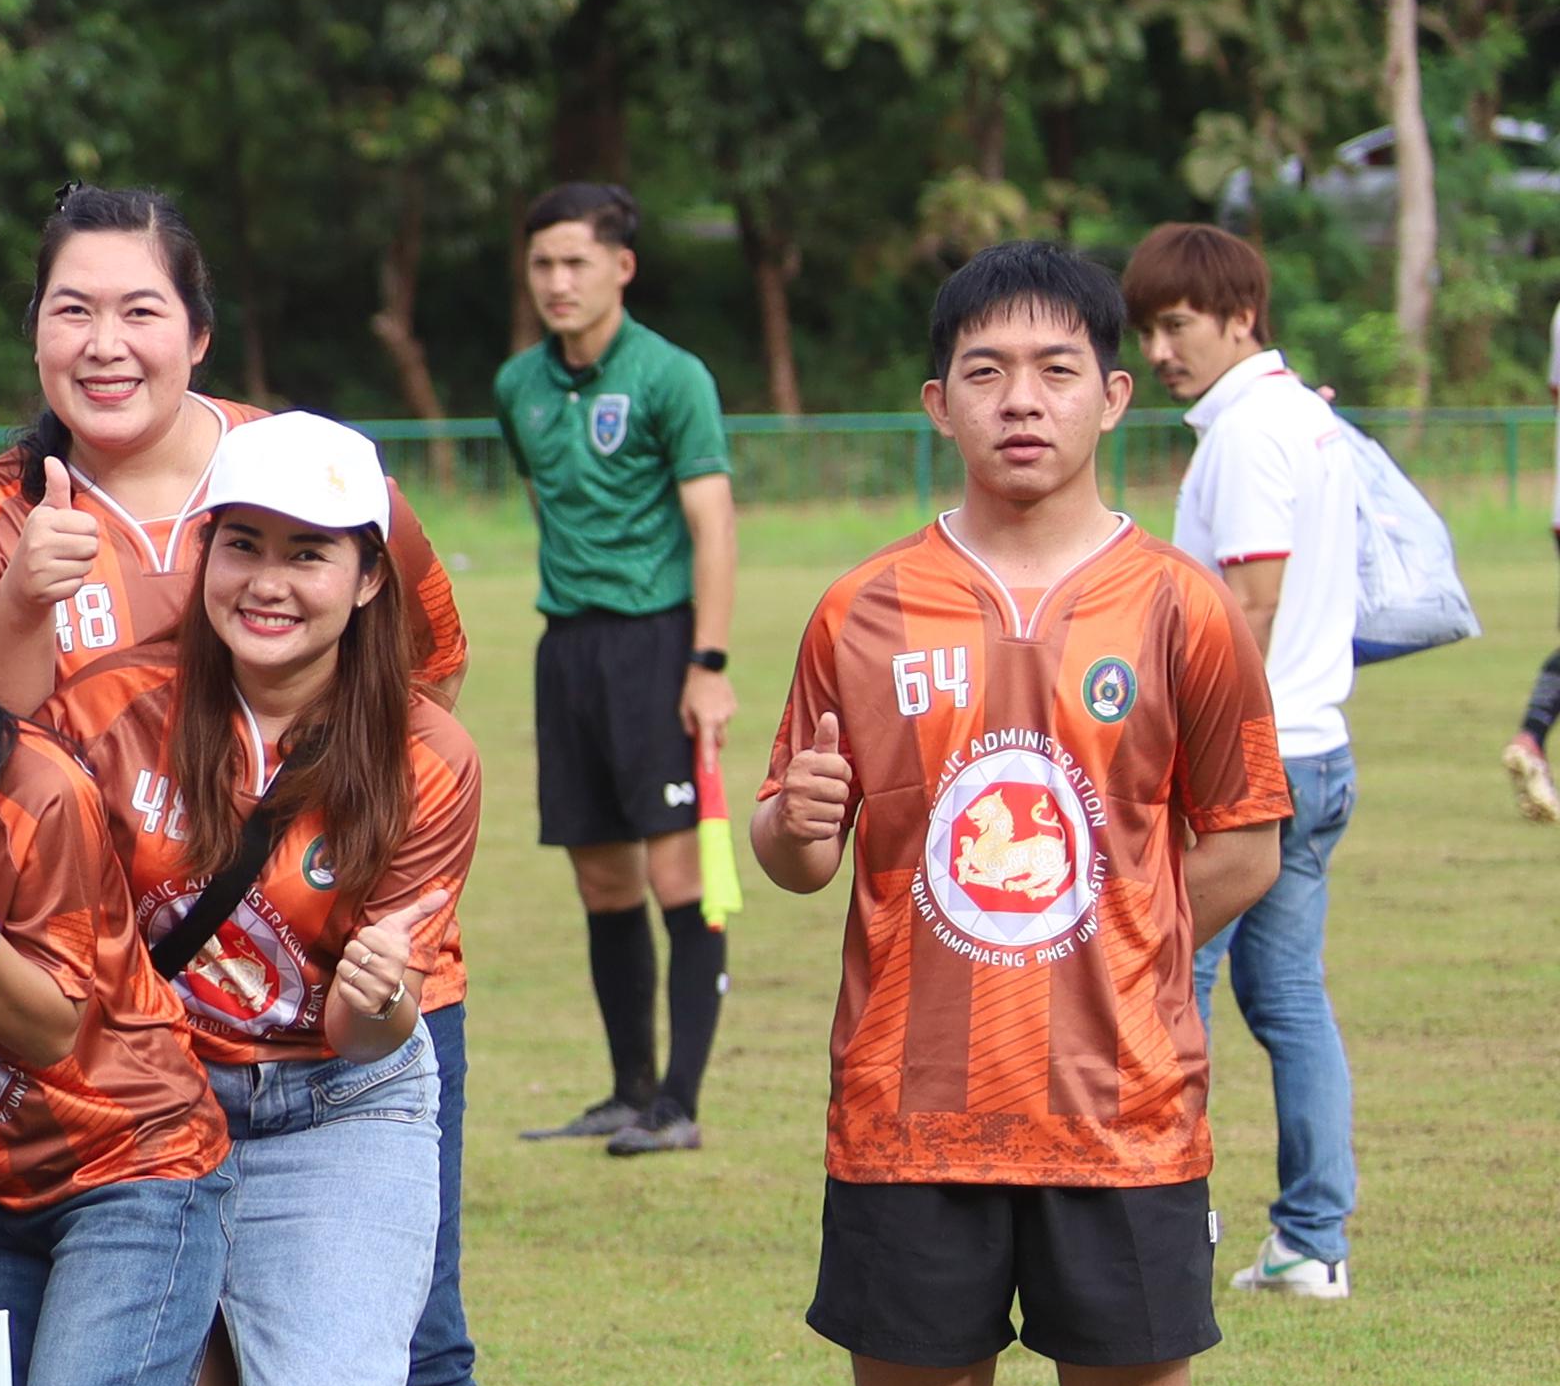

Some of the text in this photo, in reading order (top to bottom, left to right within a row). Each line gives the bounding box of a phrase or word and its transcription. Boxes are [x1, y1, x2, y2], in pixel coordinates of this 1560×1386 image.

[891, 646, 969, 717] 64
[969, 727, 1108, 828] ADMINISTRATION
[931, 923, 1026, 968] KAMPHAENG
[1035, 937, 1077, 965] PHET
